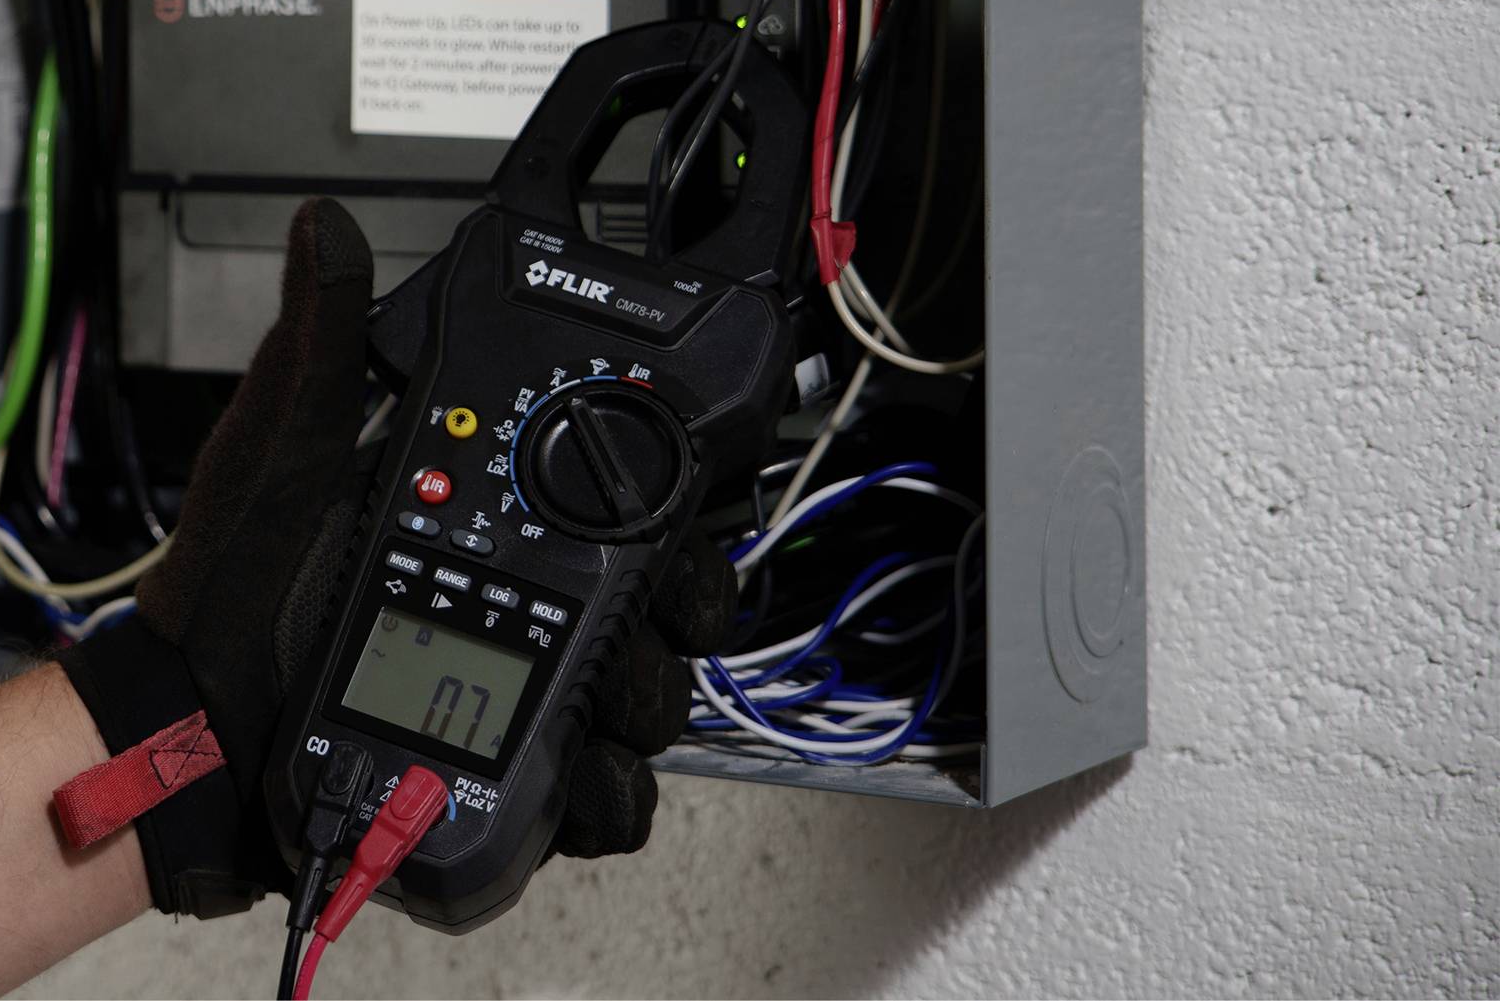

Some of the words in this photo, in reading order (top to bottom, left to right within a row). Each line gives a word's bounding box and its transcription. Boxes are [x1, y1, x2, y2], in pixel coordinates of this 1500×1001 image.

[486, 21, 509, 32] can
[513, 18, 541, 33] take
[544, 22, 563, 35] up
[566, 20, 580, 34] to
[433, 38, 447, 49] to
[488, 39, 525, 52] While
[424, 59, 473, 72] minutes
[477, 60, 507, 72] after
[462, 80, 505, 93] before
[508, 85, 546, 98] powe
[520, 236, 534, 245] CAT
[523, 229, 538, 238] CAT
[545, 235, 564, 246] 600V
[546, 268, 607, 304] FLIR
[615, 298, 666, 322] CM78-PV
[636, 367, 651, 381] IR
[519, 388, 535, 399] PV
[514, 401, 528, 413] VA
[486, 461, 509, 476] LoZ
[430, 478, 445, 494] IR
[521, 523, 545, 540] OFF
[389, 553, 419, 572] MODE
[435, 569, 469, 588] RANGE
[489, 588, 510, 603] LOG
[532, 603, 563, 622] HOLD
[306, 736, 330, 756] CO
[455, 776, 471, 791] PV
[360, 802, 374, 813] CAT
[465, 795, 486, 810] LoZ
[358, 811, 372, 821] CAT
